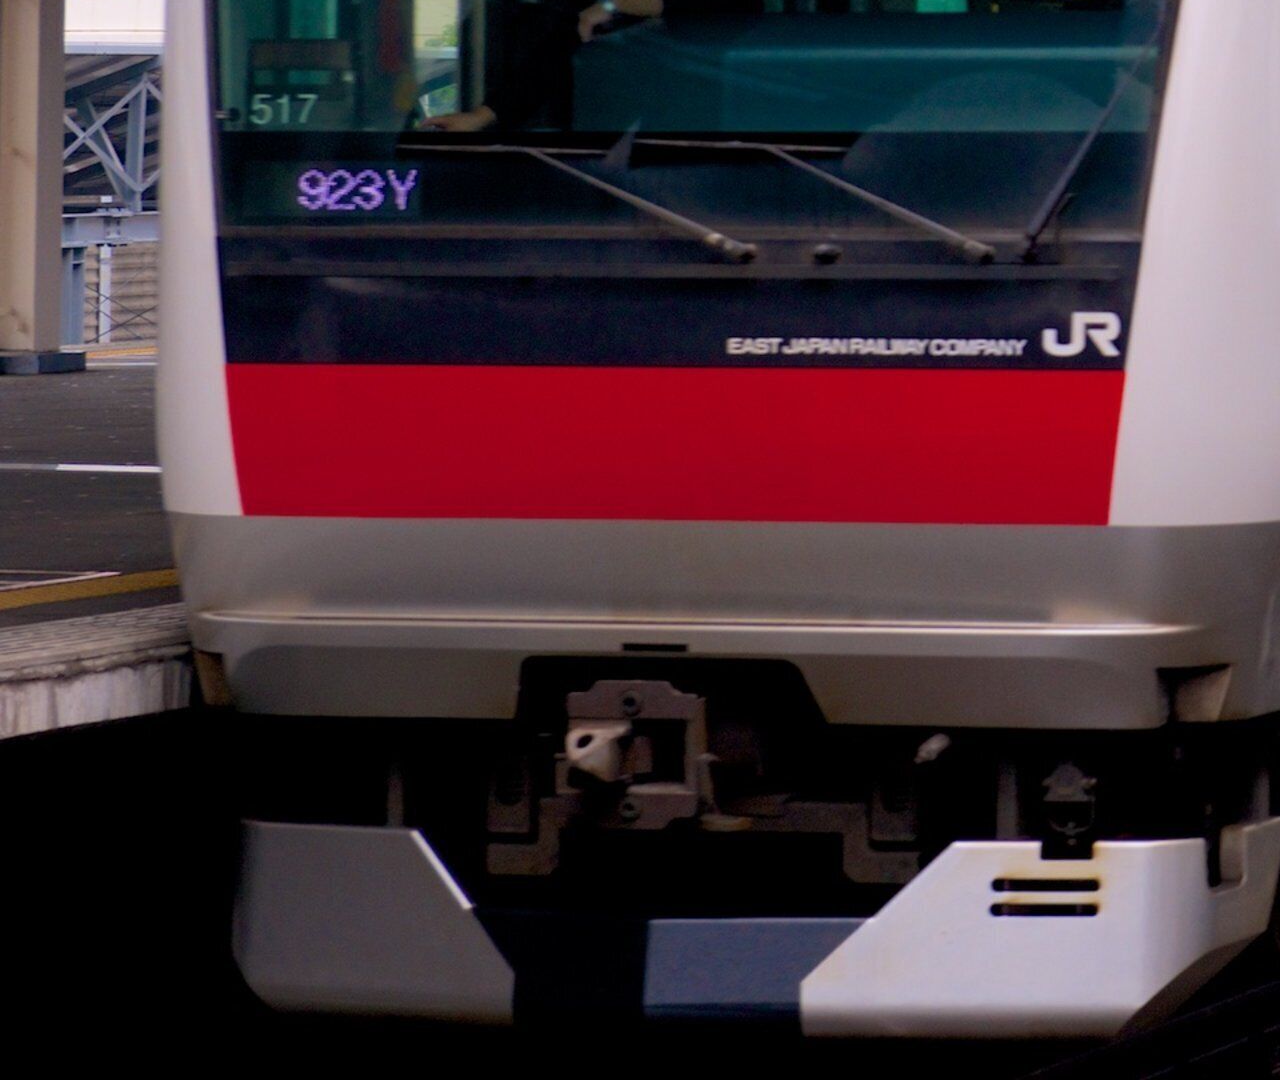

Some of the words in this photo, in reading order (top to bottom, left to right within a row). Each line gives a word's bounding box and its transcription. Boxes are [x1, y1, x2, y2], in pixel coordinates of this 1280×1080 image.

[250, 93, 318, 125] 517
[297, 168, 418, 211] 923Y
[726, 338, 782, 355] EAST
[781, 338, 849, 355] JAPAN
[850, 338, 929, 356] RAILWAY
[928, 338, 1028, 356] COMPANY
[1041, 311, 1121, 357] JR
